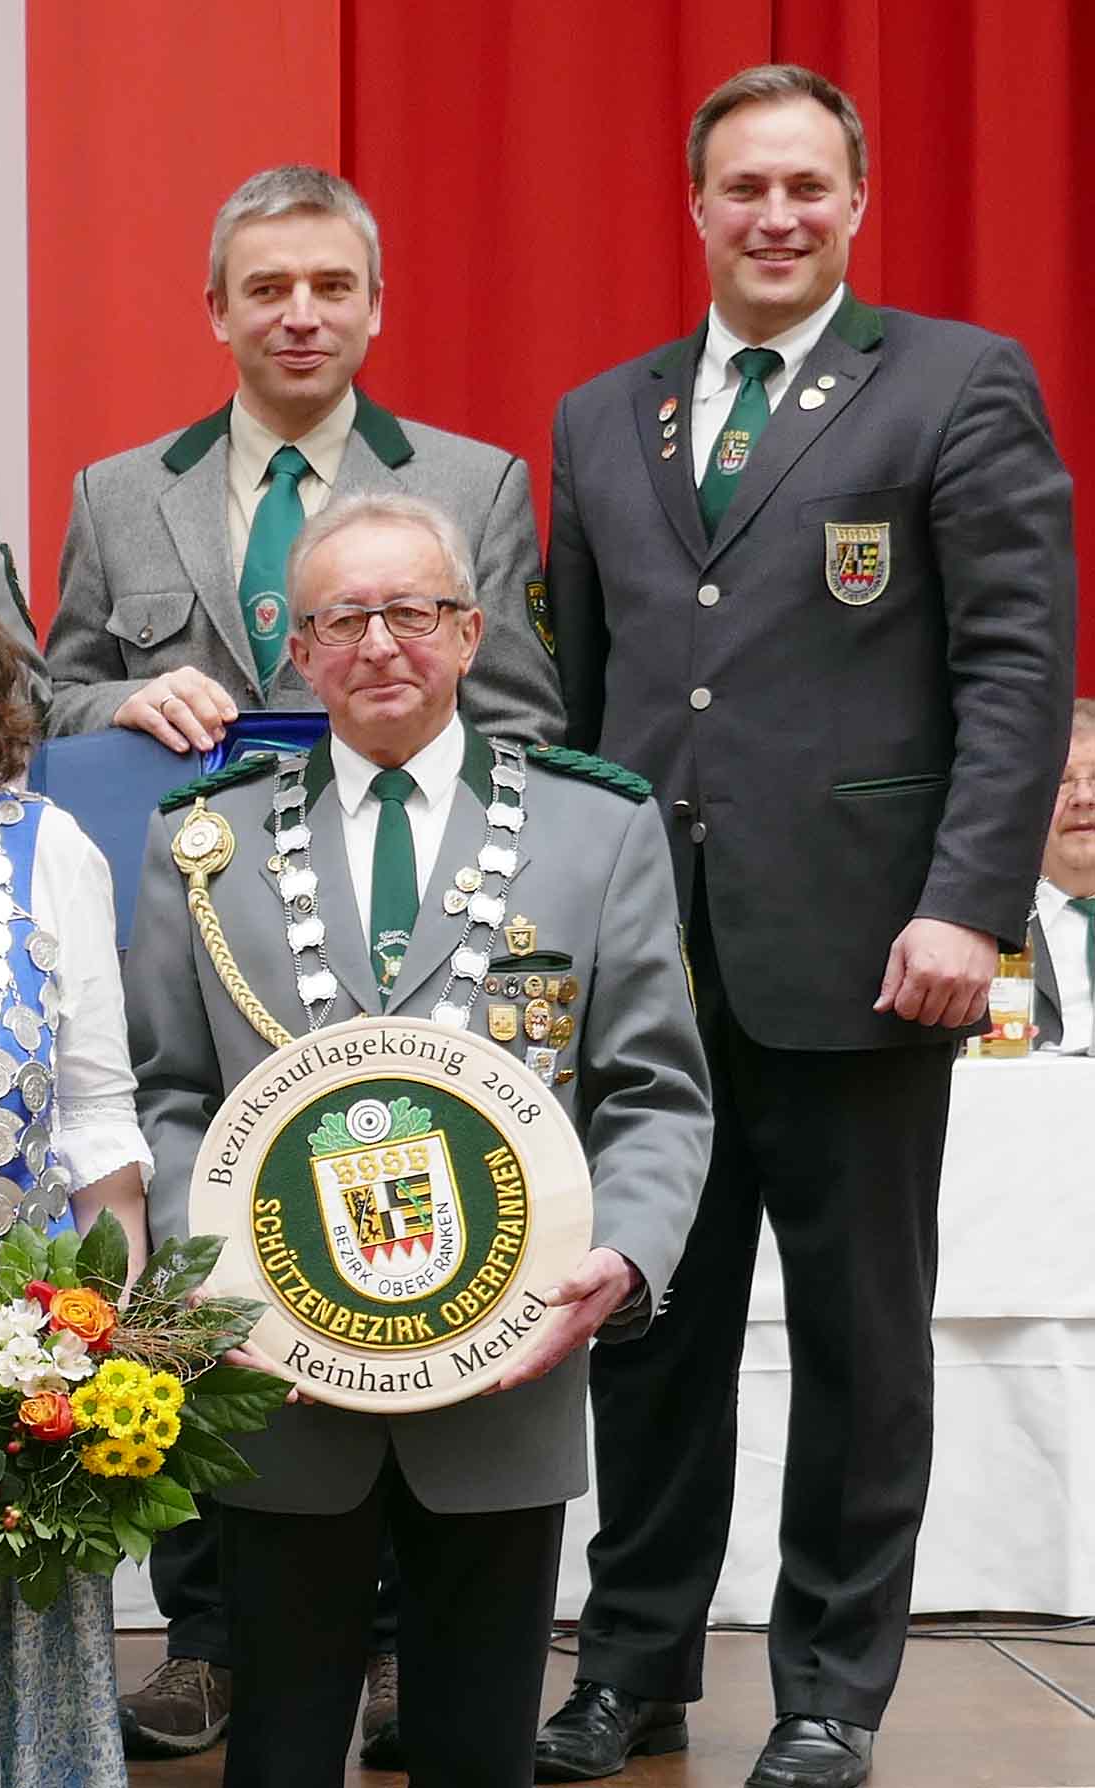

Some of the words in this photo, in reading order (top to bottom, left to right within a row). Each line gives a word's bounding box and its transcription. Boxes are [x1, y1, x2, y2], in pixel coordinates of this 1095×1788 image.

[208, 1030, 467, 1187] Bezirksauflagekönig
[481, 1071, 542, 1126] 2018
[256, 1198, 435, 1344] SCHÜTZENBEZIRK
[440, 1146, 525, 1328] OBERFRANKEN
[333, 1225, 373, 1285] BEZIRK
[378, 1202, 453, 1297] OBERFRANKEN
[283, 1339, 433, 1392] Reinhard
[449, 1290, 547, 1378] Merkel
